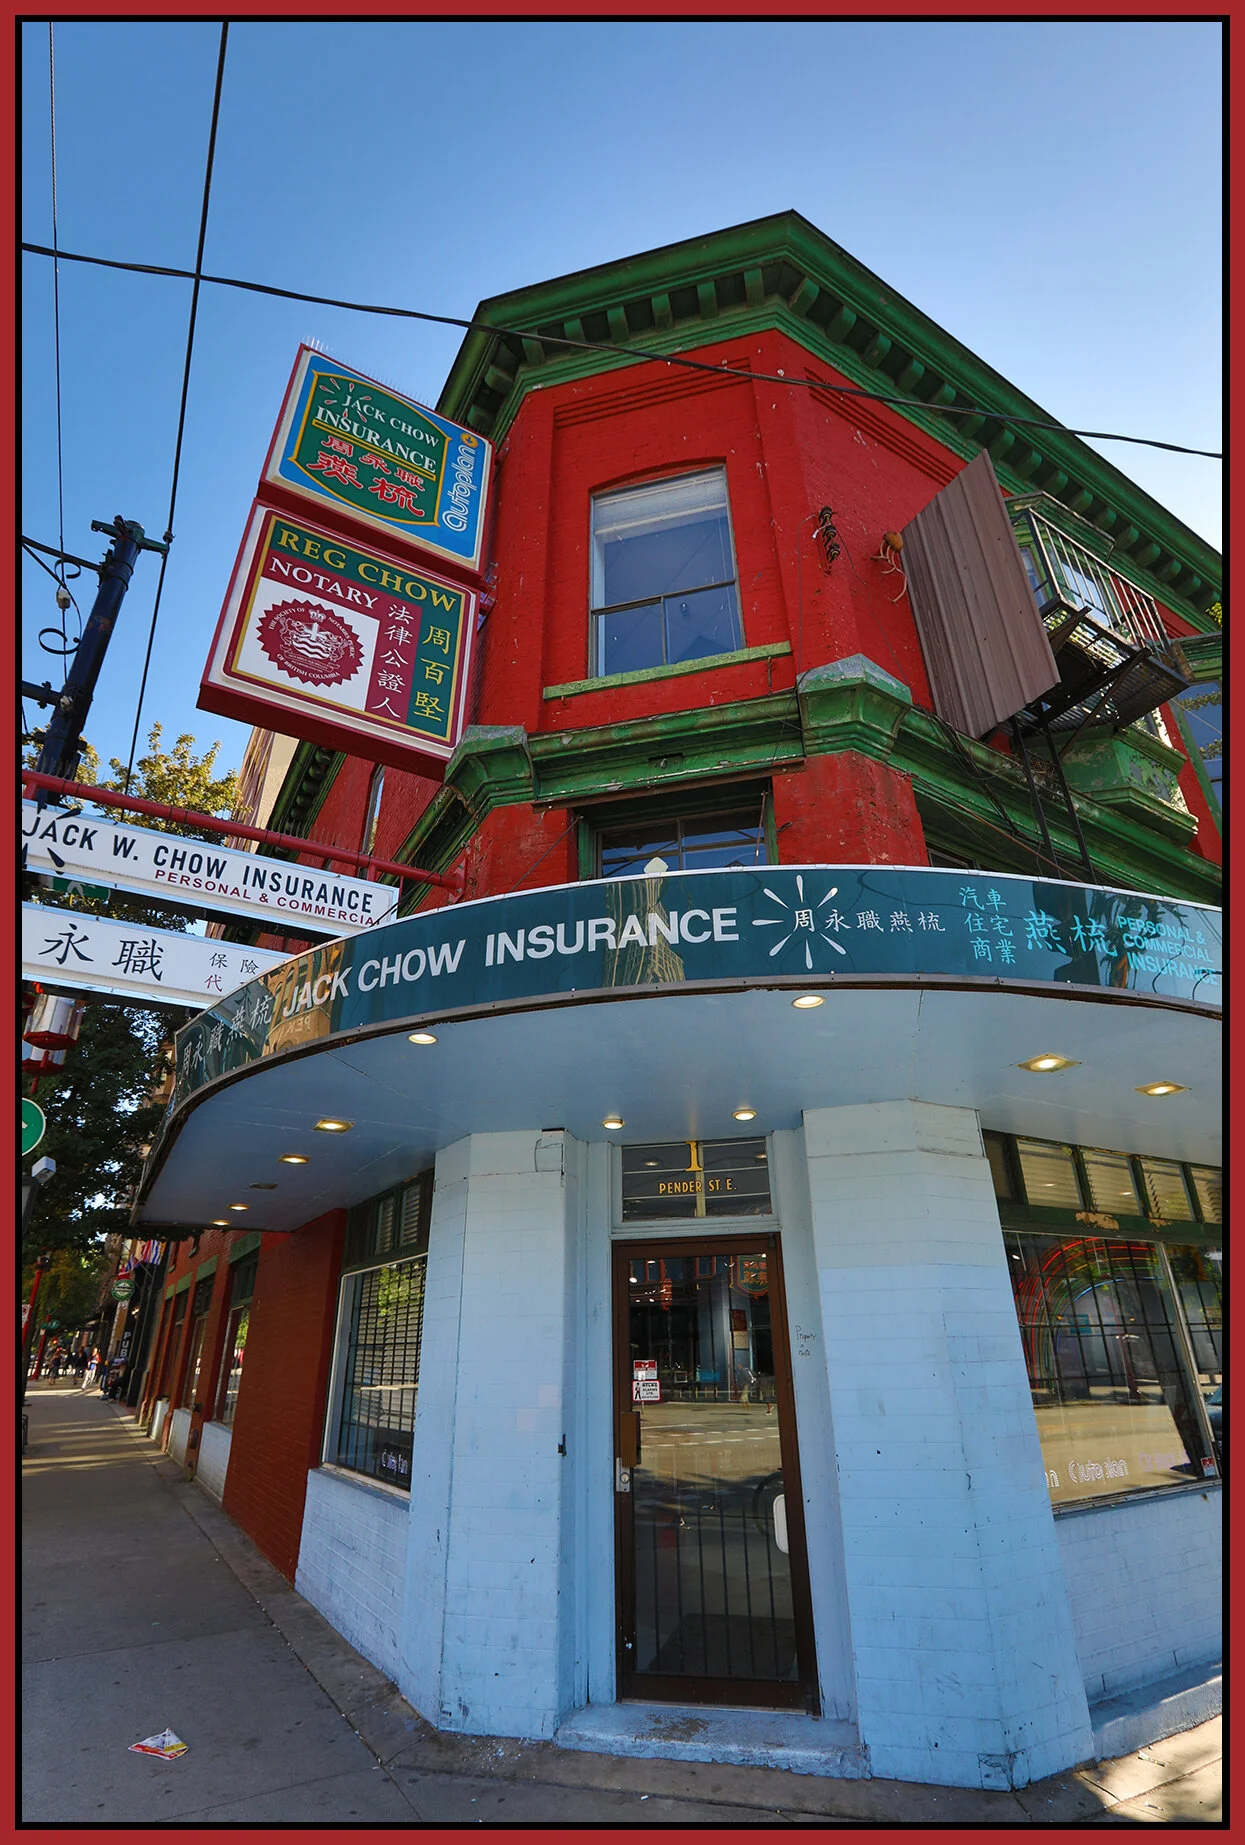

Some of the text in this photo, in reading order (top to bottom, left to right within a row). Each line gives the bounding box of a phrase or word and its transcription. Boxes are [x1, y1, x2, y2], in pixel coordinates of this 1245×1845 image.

[315, 406, 436, 474] INSURANCE
[342, 395, 440, 448] JACK CHOW
[306, 451, 426, 517] 燕梳
[269, 557, 379, 610] NOTARY
[277, 528, 457, 612] REG CHOW
[284, 661, 308, 676] BRITISH
[308, 672, 341, 680] COLUMBIA
[371, 603, 414, 719] 法律公證人
[413, 625, 452, 722] 周百堅
[22, 816, 373, 913] JACK W. CHOW INSURANCE
[155, 869, 251, 900] PERSONAL
[259, 893, 269, 903] &
[958, 886, 1008, 912] 汽車
[793, 908, 946, 933] 周永職燕梳
[964, 912, 1014, 937] 住宅
[1023, 909, 1118, 957] 燕梳
[1117, 916, 1207, 946] PERSONAL &
[38, 923, 164, 981] 永職
[209, 952, 260, 975] 保險
[283, 907, 739, 1017] JACK CHOW INSURANCE
[970, 936, 1017, 965] 商業
[1122, 933, 1214, 963] COMMERCIAL
[1127, 952, 1220, 986] INSURANCE
[659, 1178, 737, 1194] PENDER ST. E.
